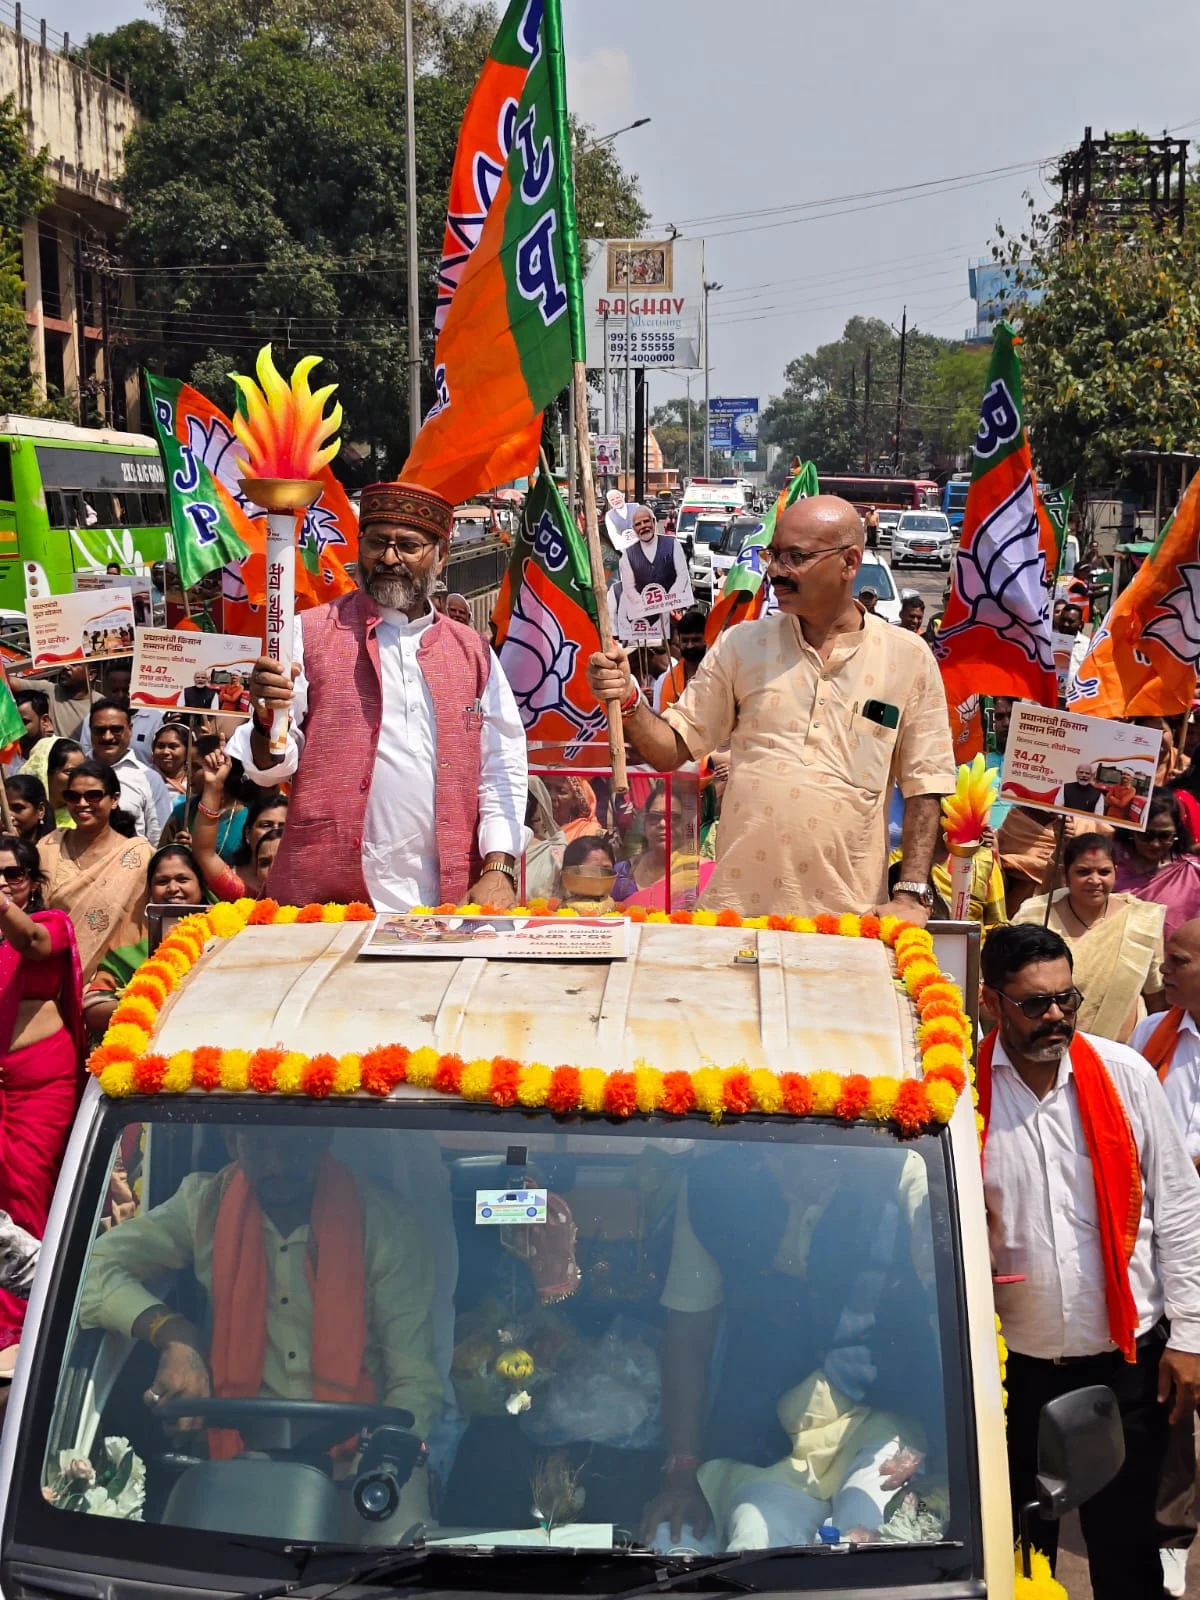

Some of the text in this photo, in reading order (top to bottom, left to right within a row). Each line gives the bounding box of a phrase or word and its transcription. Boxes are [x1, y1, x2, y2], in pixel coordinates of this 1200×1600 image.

[596, 298, 685, 315] RAGHAV
[641, 333, 675, 341] 55555
[641, 343, 675, 351] 55555
[268, 563, 285, 591] सेवा
[645, 590, 663, 604] 25
[268, 594, 285, 633] ज्योति
[634, 623, 647, 631] 25
[144, 633, 202, 646] प्रधानमंत्री किसान
[143, 642, 184, 652] सम्मान निधि
[140, 664, 168, 674] ₹4.47
[1020, 712, 1089, 733] प्रधानमंत्री किसान
[1018, 722, 1066, 738] सम्मान निधि
[1014, 748, 1046, 764] ₹4.47
[1011, 760, 1029, 771] लाख
